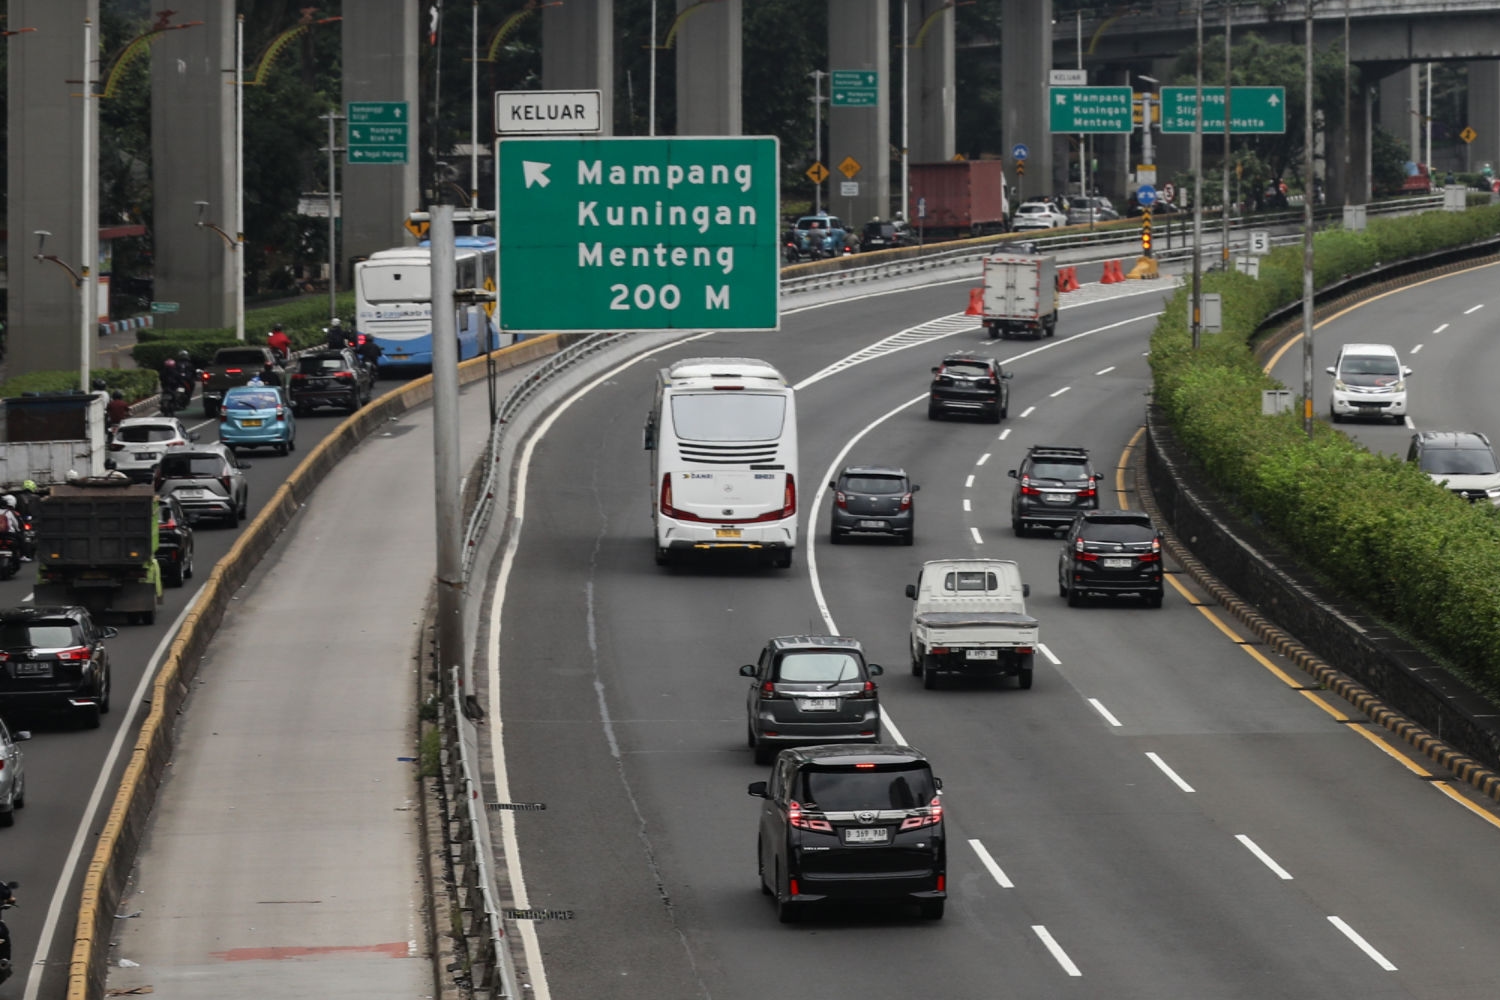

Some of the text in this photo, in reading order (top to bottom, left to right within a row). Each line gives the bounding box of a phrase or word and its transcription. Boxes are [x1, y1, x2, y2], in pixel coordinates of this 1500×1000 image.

[1073, 93, 1126, 104] Mampang
[352, 105, 384, 114] Semanggi
[511, 104, 585, 120] KELUAR
[1073, 106, 1127, 116] Kuningan
[1073, 118, 1122, 128] Menteng
[1176, 118, 1265, 127] Soearno-Hatta
[370, 127, 402, 135] Mampang
[577, 160, 752, 192] Mampang
[578, 201, 757, 233] Kuningan
[1255, 239, 1264, 250] 5
[578, 242, 734, 274] Menteng
[609, 283, 730, 310] 200 M
